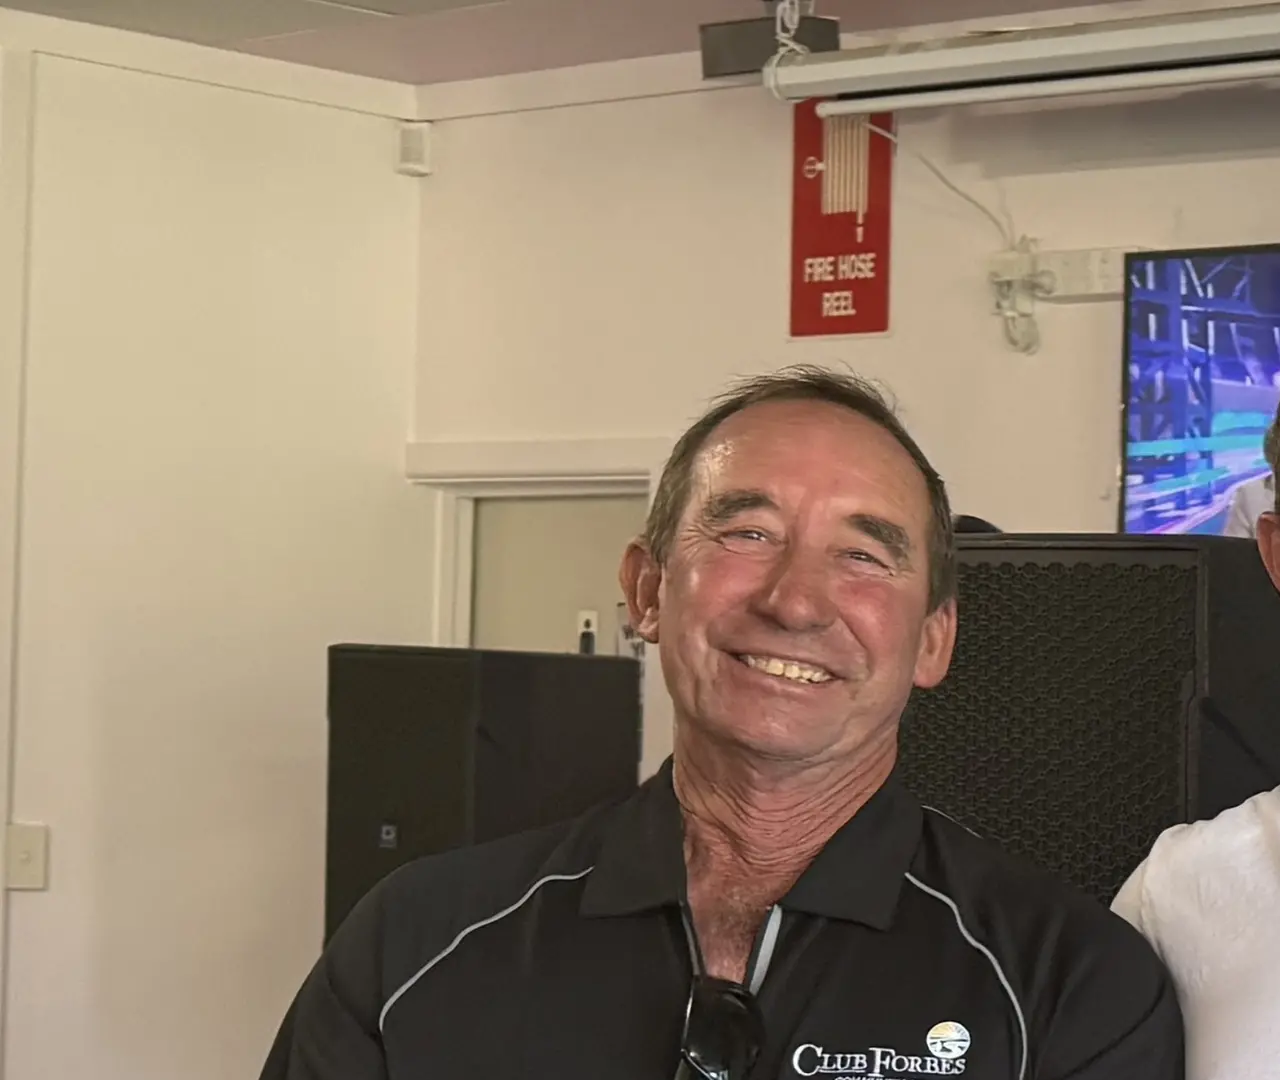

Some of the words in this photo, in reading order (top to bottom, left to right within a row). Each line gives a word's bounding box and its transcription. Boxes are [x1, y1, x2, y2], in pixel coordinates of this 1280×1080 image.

[804, 256, 835, 282] FIRE
[838, 252, 876, 280] HOSE
[822, 290, 857, 317] REEL
